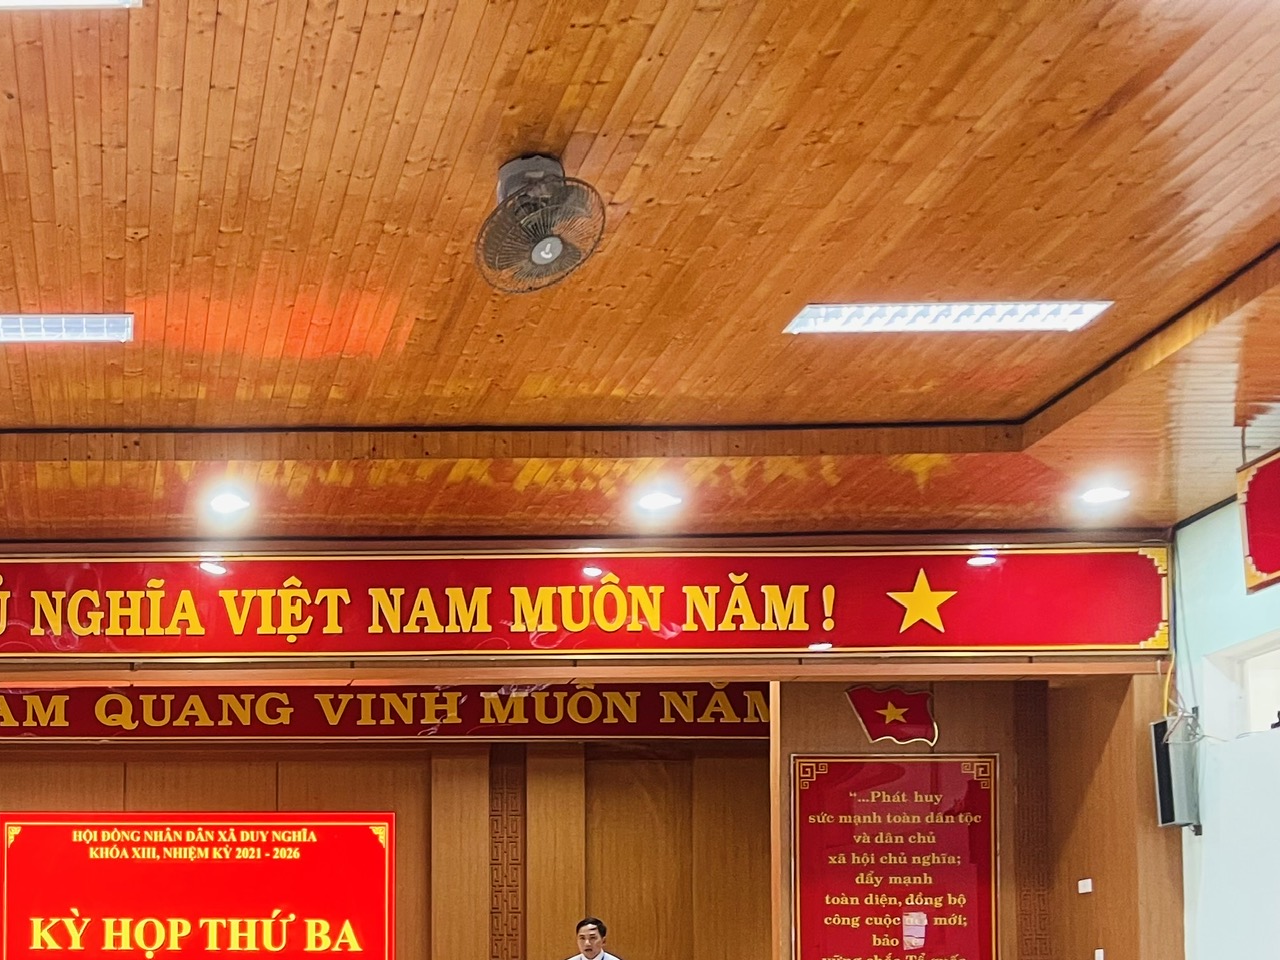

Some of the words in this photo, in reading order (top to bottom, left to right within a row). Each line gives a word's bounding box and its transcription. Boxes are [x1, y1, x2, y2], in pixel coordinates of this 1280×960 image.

[30, 578, 206, 637] NGHĨA
[219, 576, 352, 645] VIỆT
[369, 586, 499, 635] NAM
[512, 572, 664, 634] MUÔN
[94, 694, 294, 733] QUANG
[316, 693, 463, 727] VINH
[480, 682, 639, 725] MUÔN
[914, 791, 943, 804] huy
[809, 811, 834, 824] sức
[839, 813, 882, 826] mạnh
[887, 812, 921, 824] toàn
[925, 812, 955, 824] dân
[958, 813, 982, 826] tộc
[73, 828, 98, 844] HỘI
[144, 828, 182, 842] NHÂN
[186, 828, 215, 842] DÂN
[218, 828, 237, 842] XÃ
[240, 831, 269, 842] DUY
[272, 828, 317, 842] NGHĨA
[853, 832, 871, 843] và
[875, 832, 904, 843] dân
[908, 832, 936, 843] chủ
[90, 847, 129, 859] KHÓA
[132, 848, 160, 860] XIII,
[163, 847, 209, 861] NHIỆM
[212, 845, 231, 859] KỲ
[236, 847, 261, 859] 2021
[272, 847, 300, 859] 2026
[828, 854, 847, 864] xã
[851, 853, 875, 866] hội
[880, 852, 908, 864] chủ
[912, 853, 961, 866] nghĩa;
[825, 893, 860, 905] toàn
[864, 894, 903, 907] diện,
[947, 894, 967, 907] bộ
[29, 907, 91, 951] KỲ
[102, 917, 191, 960] HỌP
[199, 909, 296, 952] THỨ
[304, 918, 363, 952] BA
